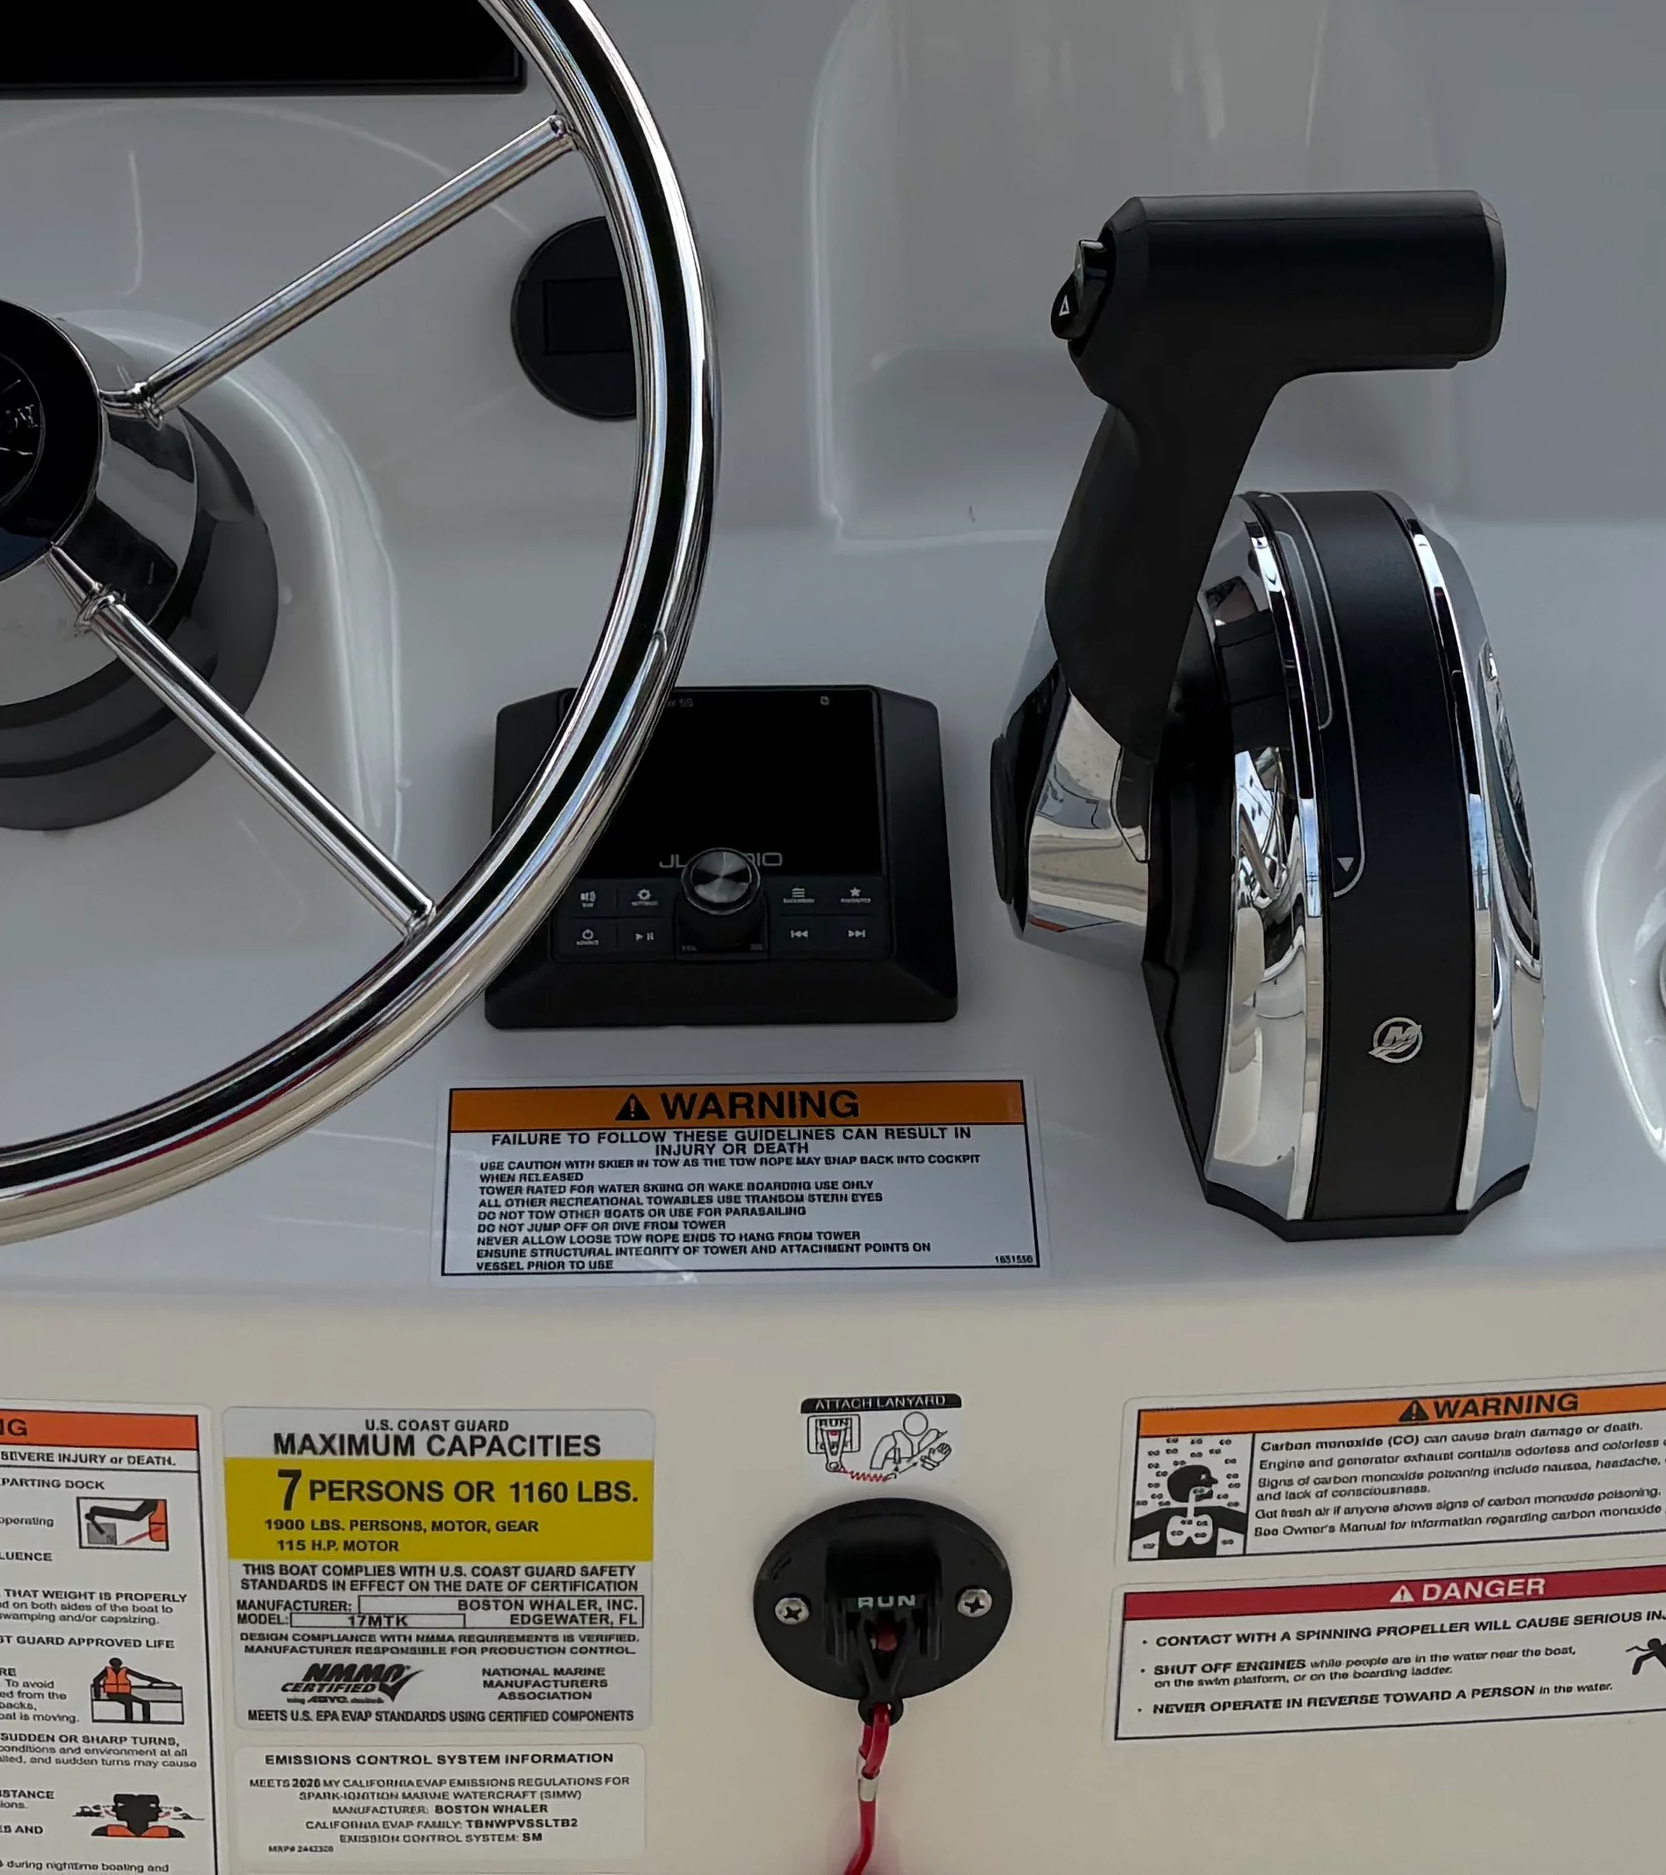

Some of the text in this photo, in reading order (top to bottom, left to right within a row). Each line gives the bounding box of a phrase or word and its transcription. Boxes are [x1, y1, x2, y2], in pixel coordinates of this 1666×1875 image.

[661, 1090, 859, 1120] WARNING
[491, 1126, 971, 1146] FAILURE TO FOLLOW THESE GUIDELINES CAN RESULT IN
[655, 1141, 809, 1156] INJURY OR DEATH
[477, 1219, 726, 1233] DO NOT JUMP OFF OR DIVE FROM TOWER
[815, 1395, 946, 1410] ATTACH LANYARD
[1434, 1392, 1578, 1419] WARNING
[365, 1419, 509, 1432] U.S. COAST GUARD
[1260, 1421, 1642, 1452] Carbon monoxide (CO) can cause brain damage or death.
[274, 1433, 600, 1457] MAXIMUM CAPACITIES
[277, 1469, 638, 1511] 7 PERSONS OR 1160 LBS.
[265, 1518, 539, 1533] 1900 LBS. PERSONS, MOTOR, GEAR
[277, 1539, 399, 1552] 115 H.P. MOTOR
[242, 1563, 636, 1578] THIS BOAT COMPLIES WITH U.S. COAST GUARD SAFETY
[241, 1578, 638, 1593] STANDARDS IN EFFECT ON THE DATE OF CERTIFICATION
[1422, 1578, 1545, 1601] DANGER
[236, 1599, 351, 1612] MANUFACTURER:
[457, 1598, 638, 1612] BOSTON WHALER, INC.
[857, 1594, 917, 1610] RUN
[237, 1613, 288, 1625] MODEL:
[348, 1615, 408, 1627] 17MTK
[510, 1613, 638, 1626] EDGEWATER, FL
[1156, 1633, 1232, 1647] CONTACT
[1236, 1632, 1277, 1644] WITH
[1280, 1631, 1292, 1642] A
[1296, 1627, 1372, 1641] SPINNING
[1376, 1622, 1470, 1636] PROPELLER
[1474, 1619, 1512, 1631] WILL
[1515, 1615, 1569, 1629] CAUSE
[1573, 1611, 1642, 1626] SERIOUS
[16, 1635, 65, 1646] GUARD
[68, 1637, 142, 1648] APPROVED
[145, 1639, 175, 1649] LIFE
[481, 1667, 605, 1677] NATIONAL MARINE
[1154, 1659, 1306, 1676] SHUT OFF ENGINES
[281, 1682, 376, 1693] CERTIFIED
[483, 1679, 608, 1689] MANUFACTURERS
[498, 1691, 592, 1701] ASSOCIATION
[247, 1709, 634, 1723] MEETS U.S. EPA EVAP STANDARDS USING CERTIFIED COMPONENTS
[265, 1753, 613, 1765] EMISSIONS CONTROL SYSTEM INFORMATION
[435, 1804, 548, 1815] BOSTON WHALER
[522, 1832, 543, 1842] SM
